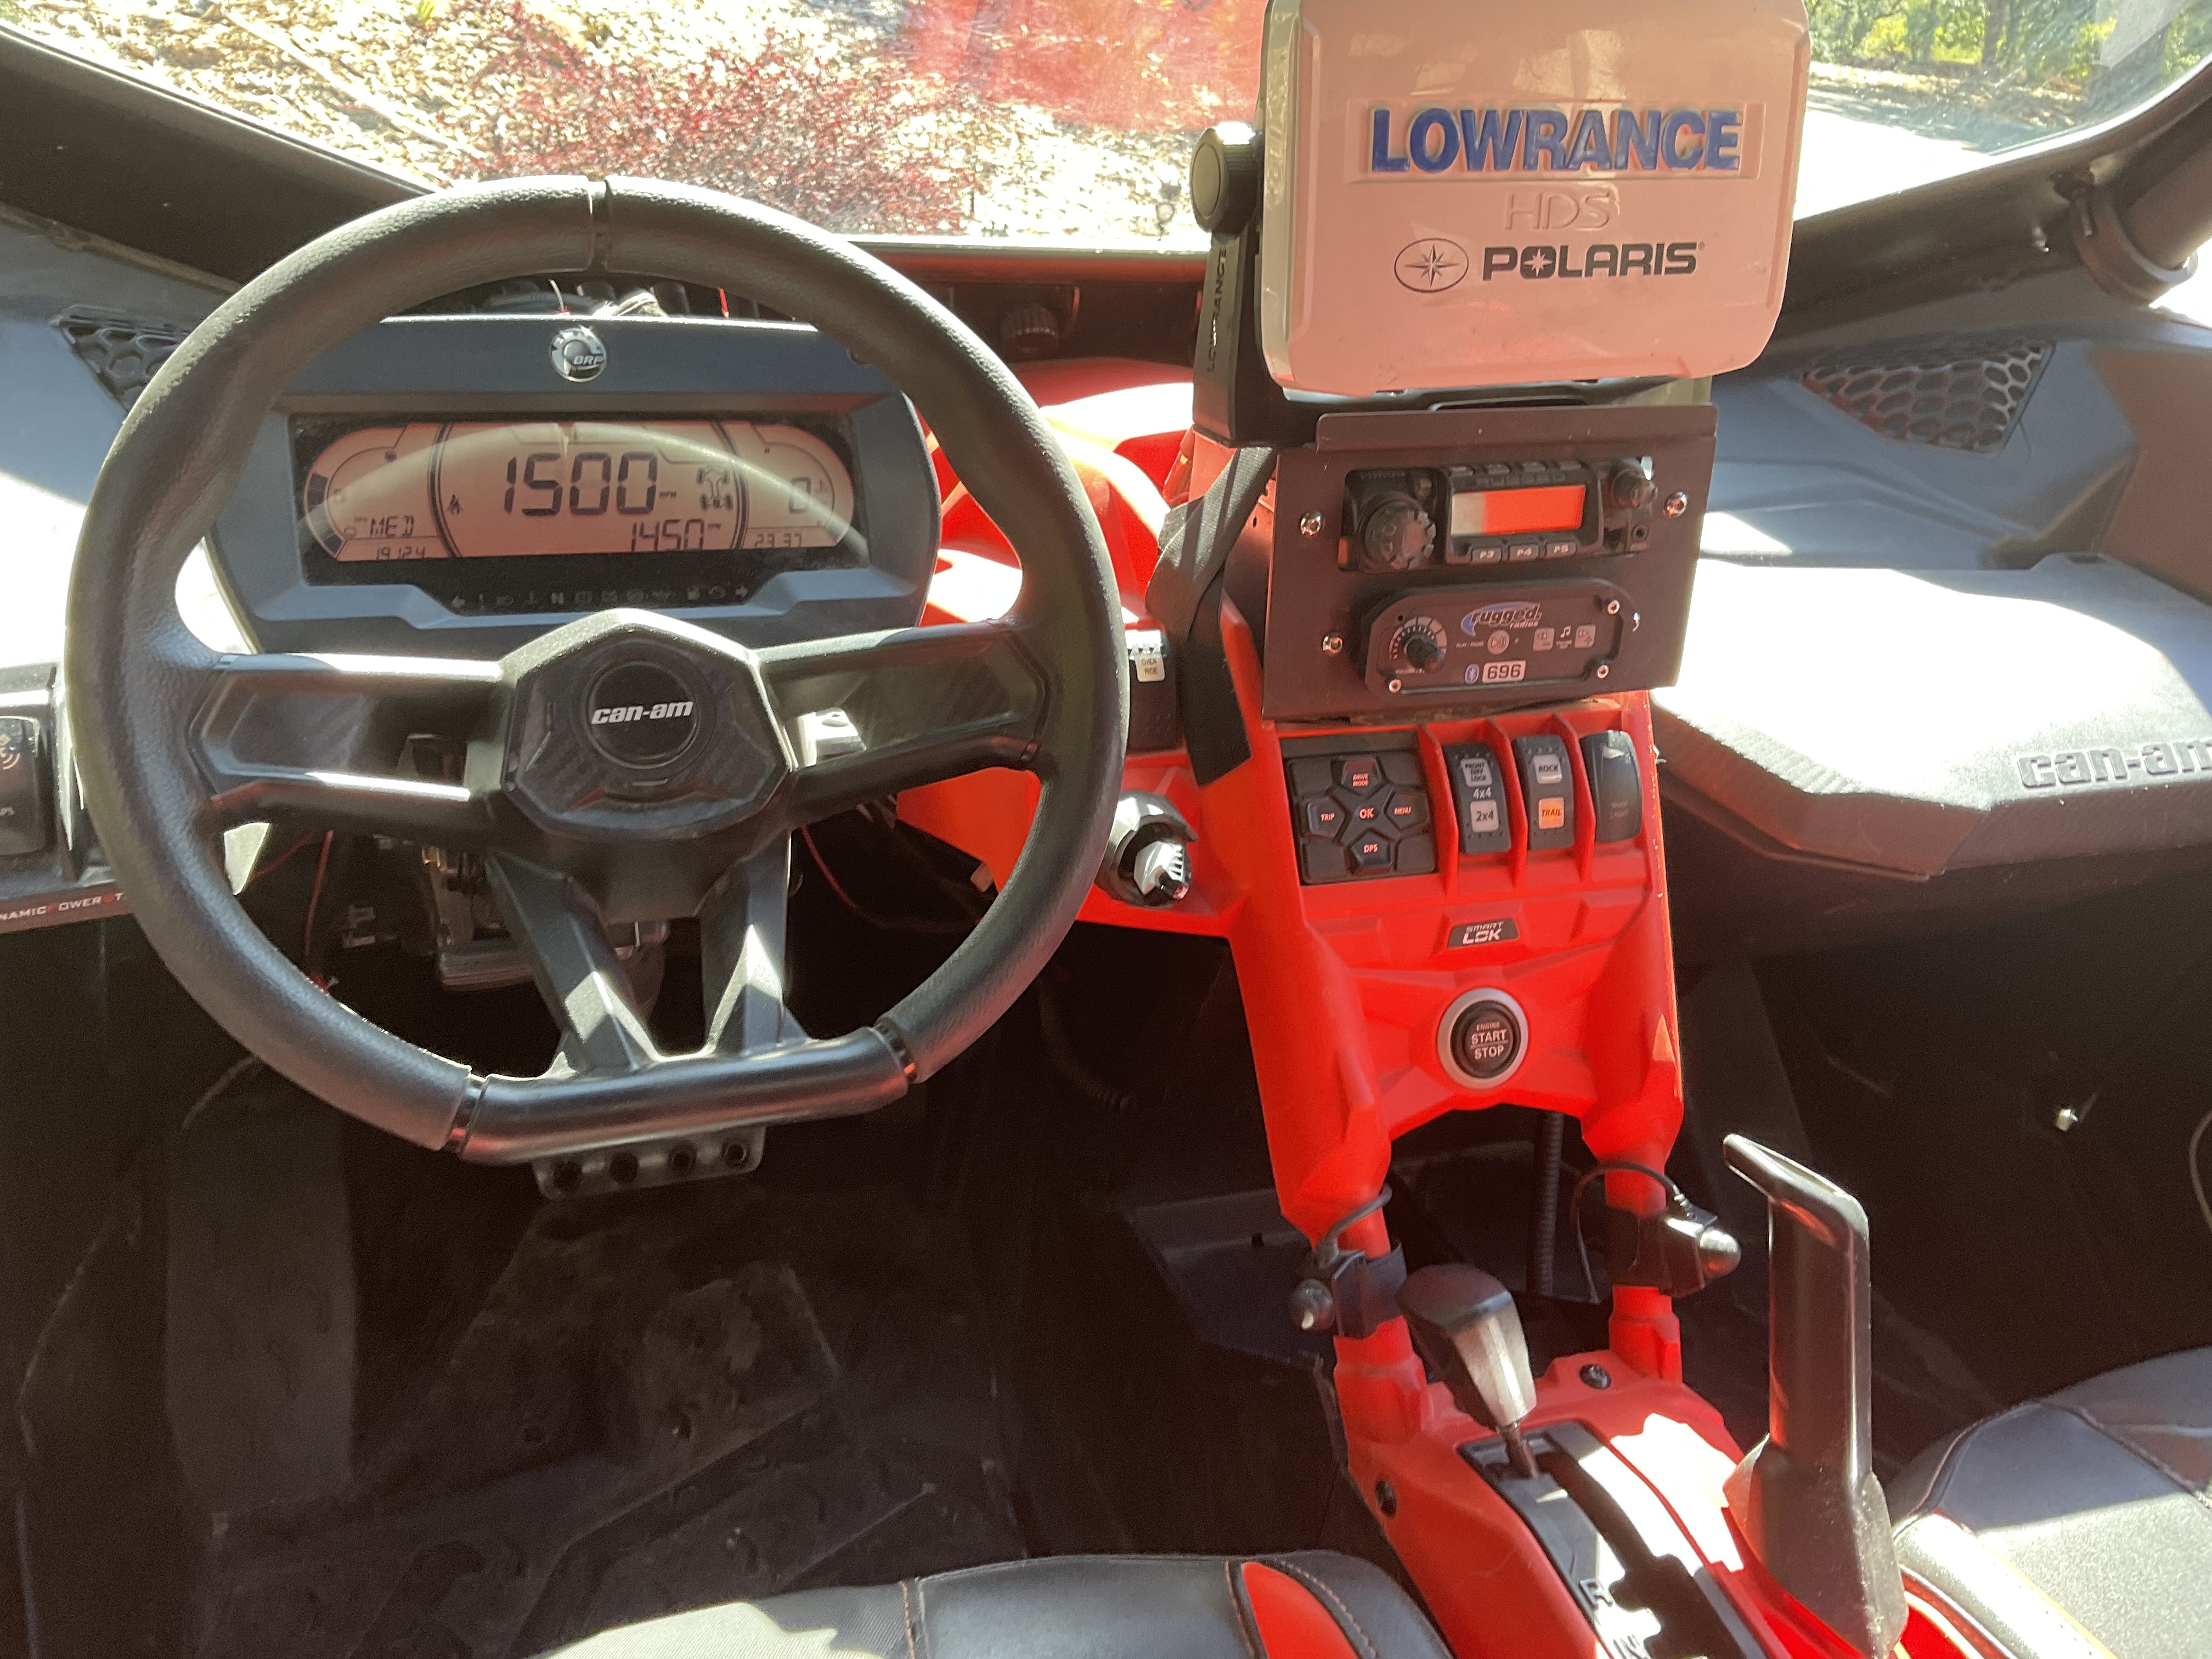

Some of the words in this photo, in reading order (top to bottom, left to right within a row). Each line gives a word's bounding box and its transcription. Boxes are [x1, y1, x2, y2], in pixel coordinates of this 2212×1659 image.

[1372, 109, 1741, 173] LOWRANCE
[1504, 189, 1613, 232] HDS
[1482, 241, 1698, 281] POLARIS
[1207, 248, 1227, 373] LOWRANCE
[504, 451, 658, 517] 1500
[369, 516, 415, 538] MED
[631, 518, 705, 552] 1450
[1144, 667, 1158, 676] RIDE
[1487, 664, 1521, 679] 696
[591, 701, 693, 725] can-am
[1538, 764, 1559, 772] ROCK
[2017, 739, 2212, 789] can-am
[1472, 787, 1492, 800] 4x4
[1321, 813, 1335, 822] TRIP
[1359, 807, 1374, 820] OK
[1394, 806, 1412, 815] MENU
[1475, 810, 1494, 822] 2x4
[1541, 808, 1562, 817] TRAIL
[1363, 843, 1378, 854] DPS
[1465, 921, 1505, 933] SMART
[1476, 1022, 1500, 1031] ENGINE
[1471, 1029, 1508, 1045] START
[1474, 1045, 1504, 1060] STOP
[1579, 1578, 1613, 1611] R
